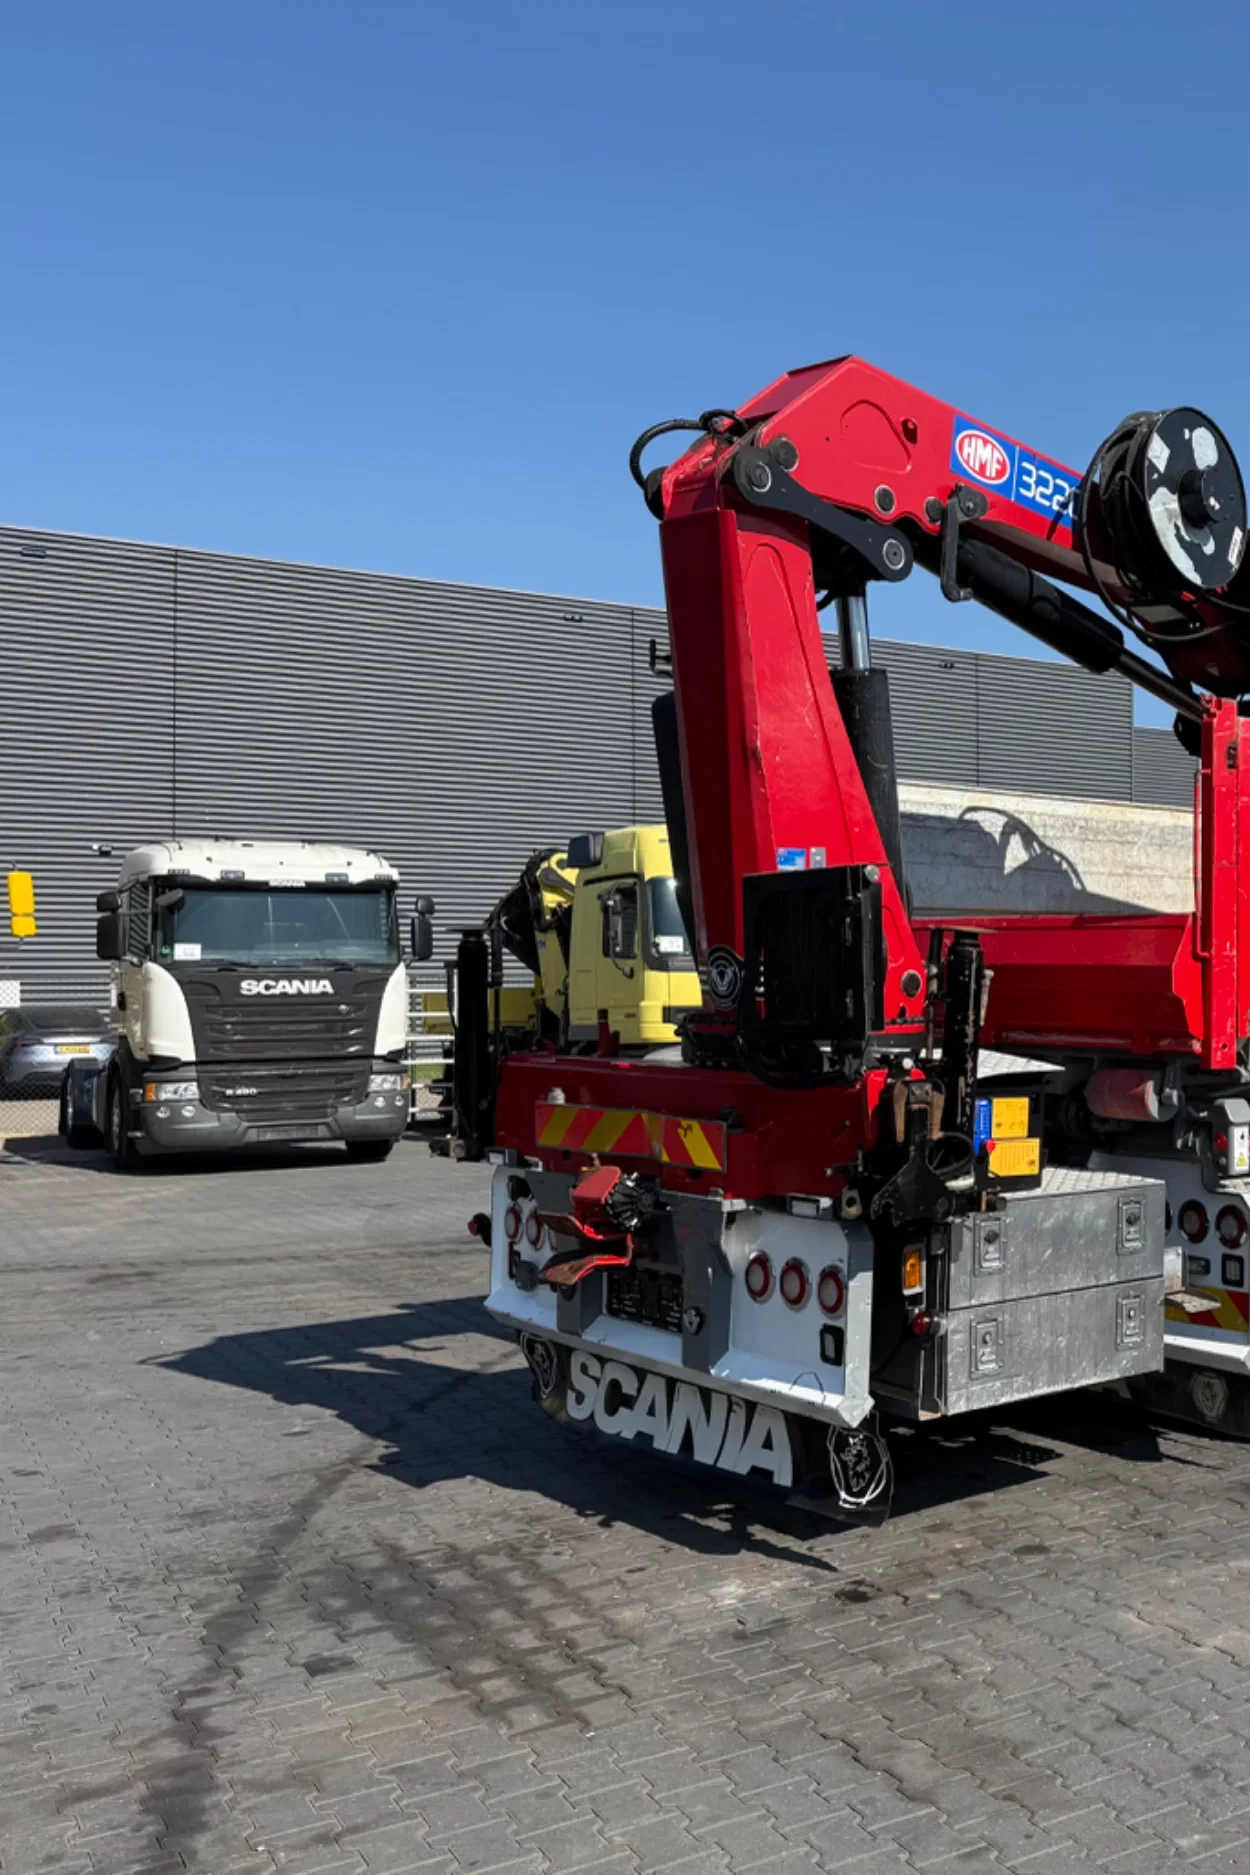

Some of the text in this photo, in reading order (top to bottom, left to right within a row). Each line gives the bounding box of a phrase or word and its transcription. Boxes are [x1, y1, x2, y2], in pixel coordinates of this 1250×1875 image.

[962, 437, 1003, 478] HMF
[240, 979, 334, 996] SCANIA
[566, 1350, 794, 1488] SCANIA
